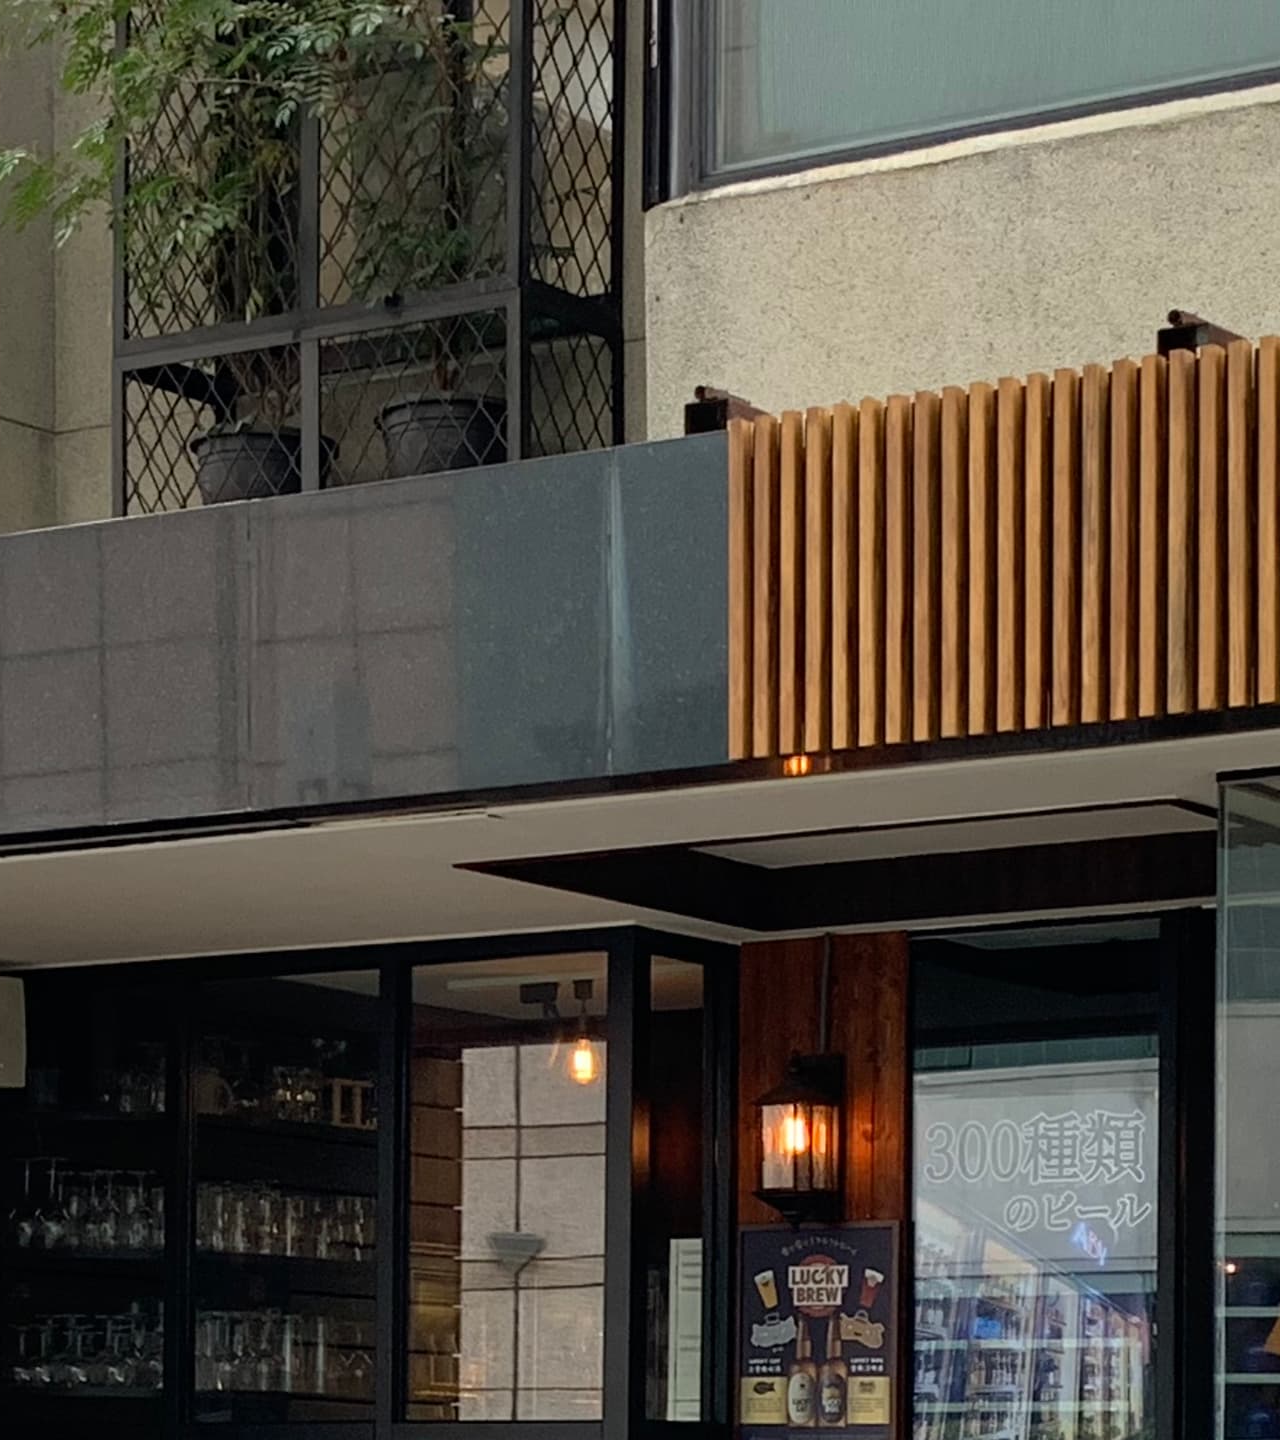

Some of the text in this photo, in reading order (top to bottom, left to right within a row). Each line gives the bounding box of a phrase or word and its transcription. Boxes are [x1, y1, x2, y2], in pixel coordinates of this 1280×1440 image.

[924, 1110, 1147, 1185] 300種類
[1003, 1191, 1153, 1232] のビール
[790, 1267, 847, 1287] LUCKY
[795, 1287, 841, 1304] BREW
